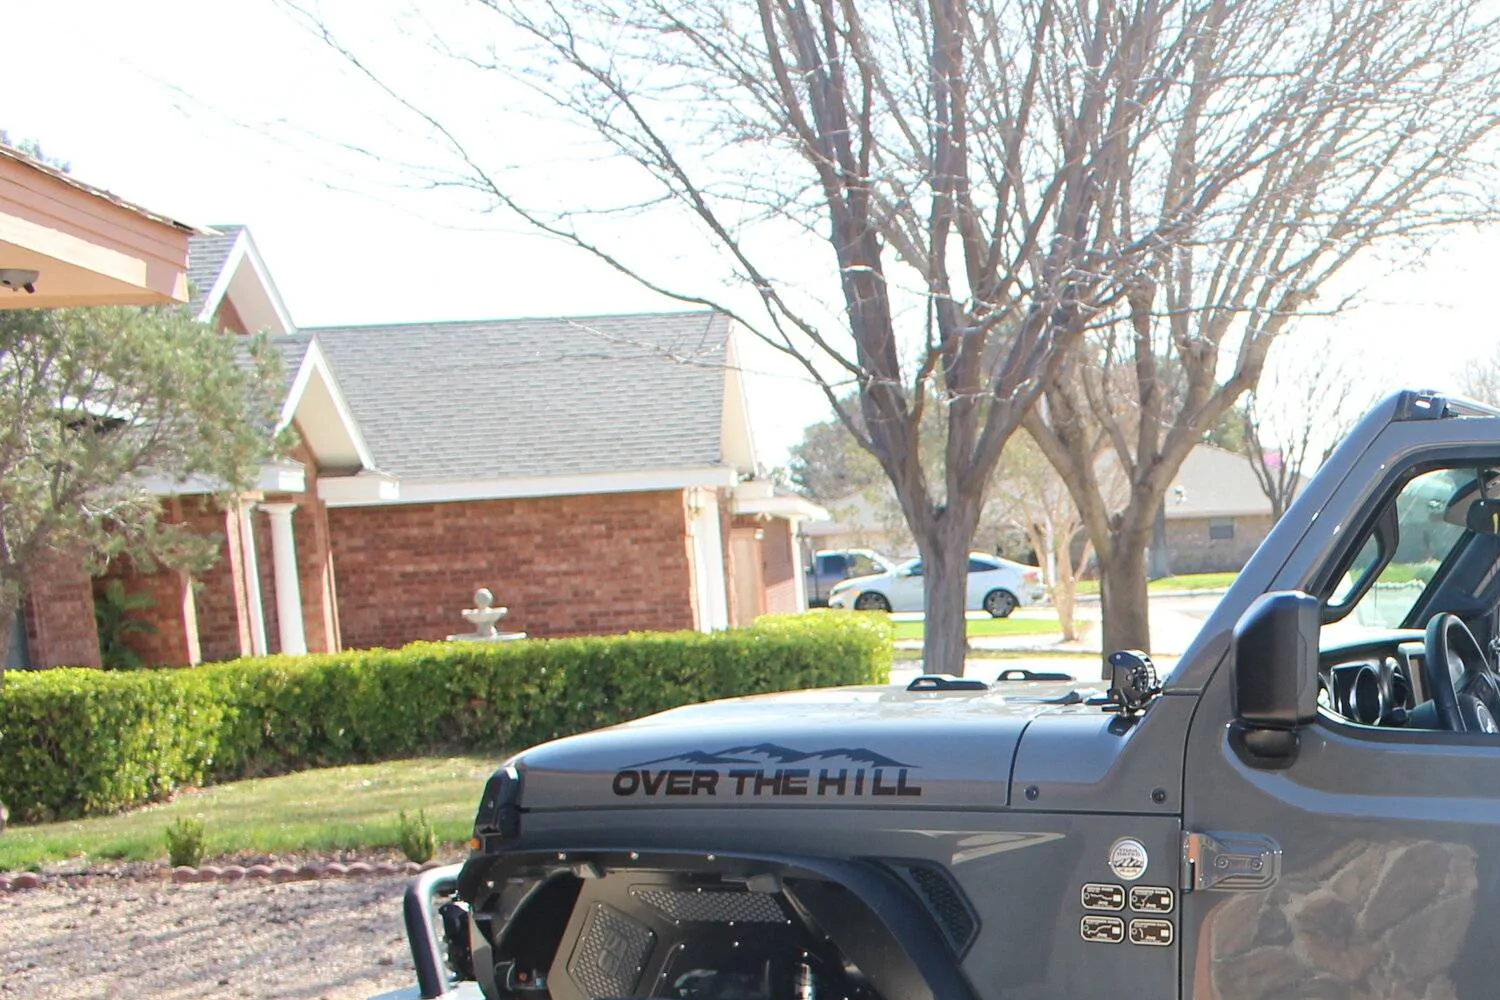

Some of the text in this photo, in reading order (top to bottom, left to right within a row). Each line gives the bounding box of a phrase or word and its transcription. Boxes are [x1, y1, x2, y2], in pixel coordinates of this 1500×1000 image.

[612, 769, 922, 796] OVER THE HILL
